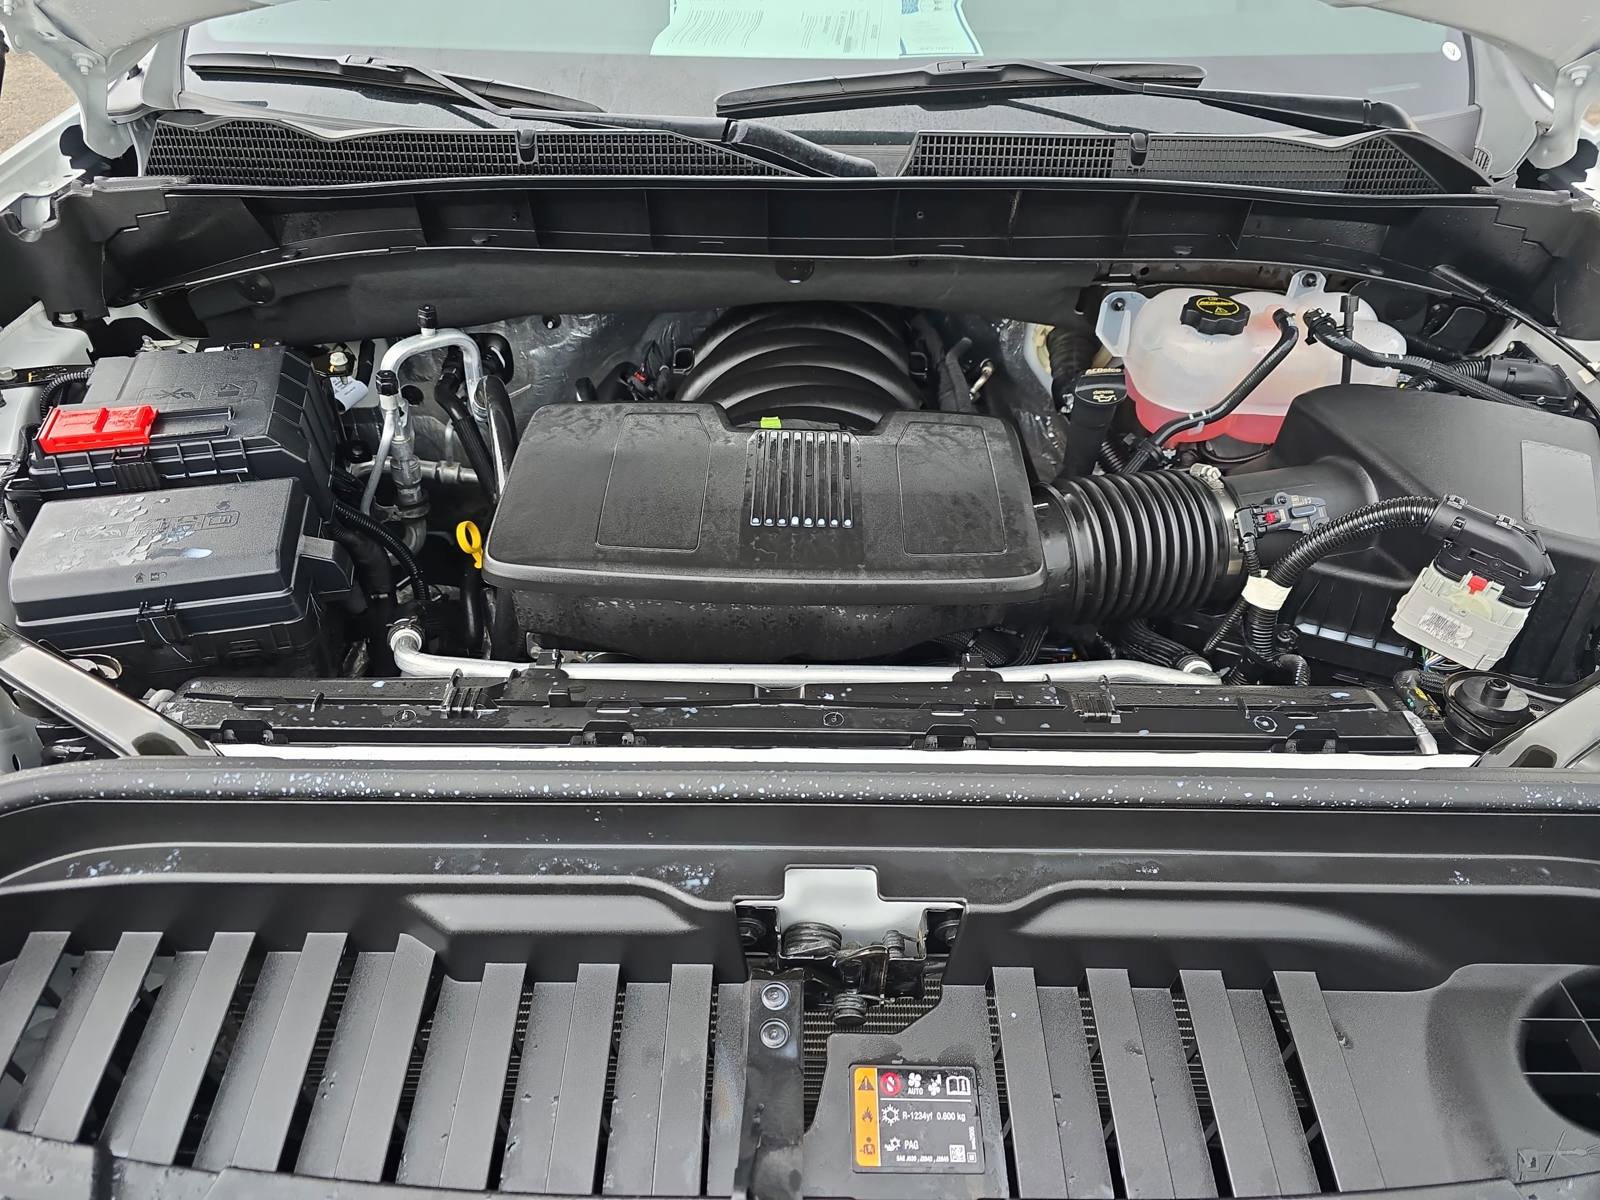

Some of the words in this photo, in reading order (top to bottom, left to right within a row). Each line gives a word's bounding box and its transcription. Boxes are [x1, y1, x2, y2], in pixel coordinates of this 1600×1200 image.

[1085, 367, 1122, 375] ACDelco
[907, 1087, 924, 1096] AUTO
[956, 1112, 966, 1123] kg
[904, 1139, 919, 1150] PAG
